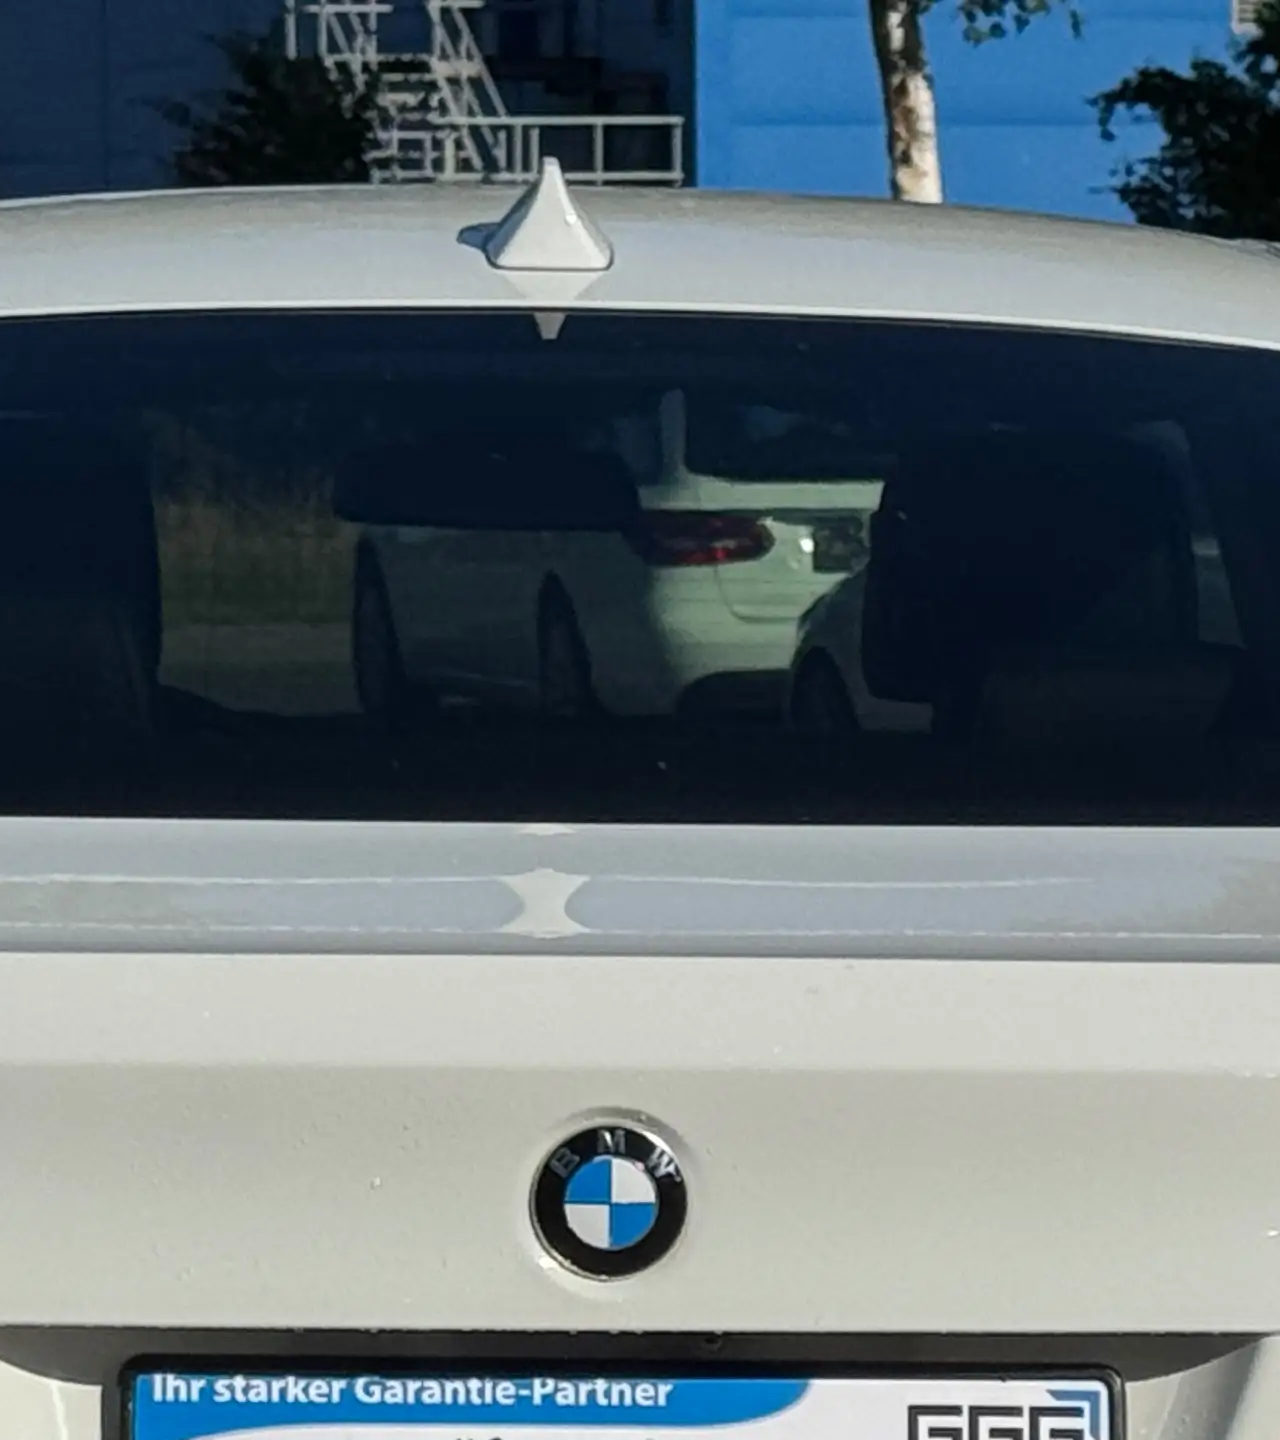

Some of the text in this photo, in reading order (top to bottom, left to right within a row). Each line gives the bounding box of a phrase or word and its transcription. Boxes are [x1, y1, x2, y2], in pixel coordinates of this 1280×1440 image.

[548, 1129, 681, 1182] BMW
[152, 1373, 673, 1407] Ihr starker Garantie-Partner
